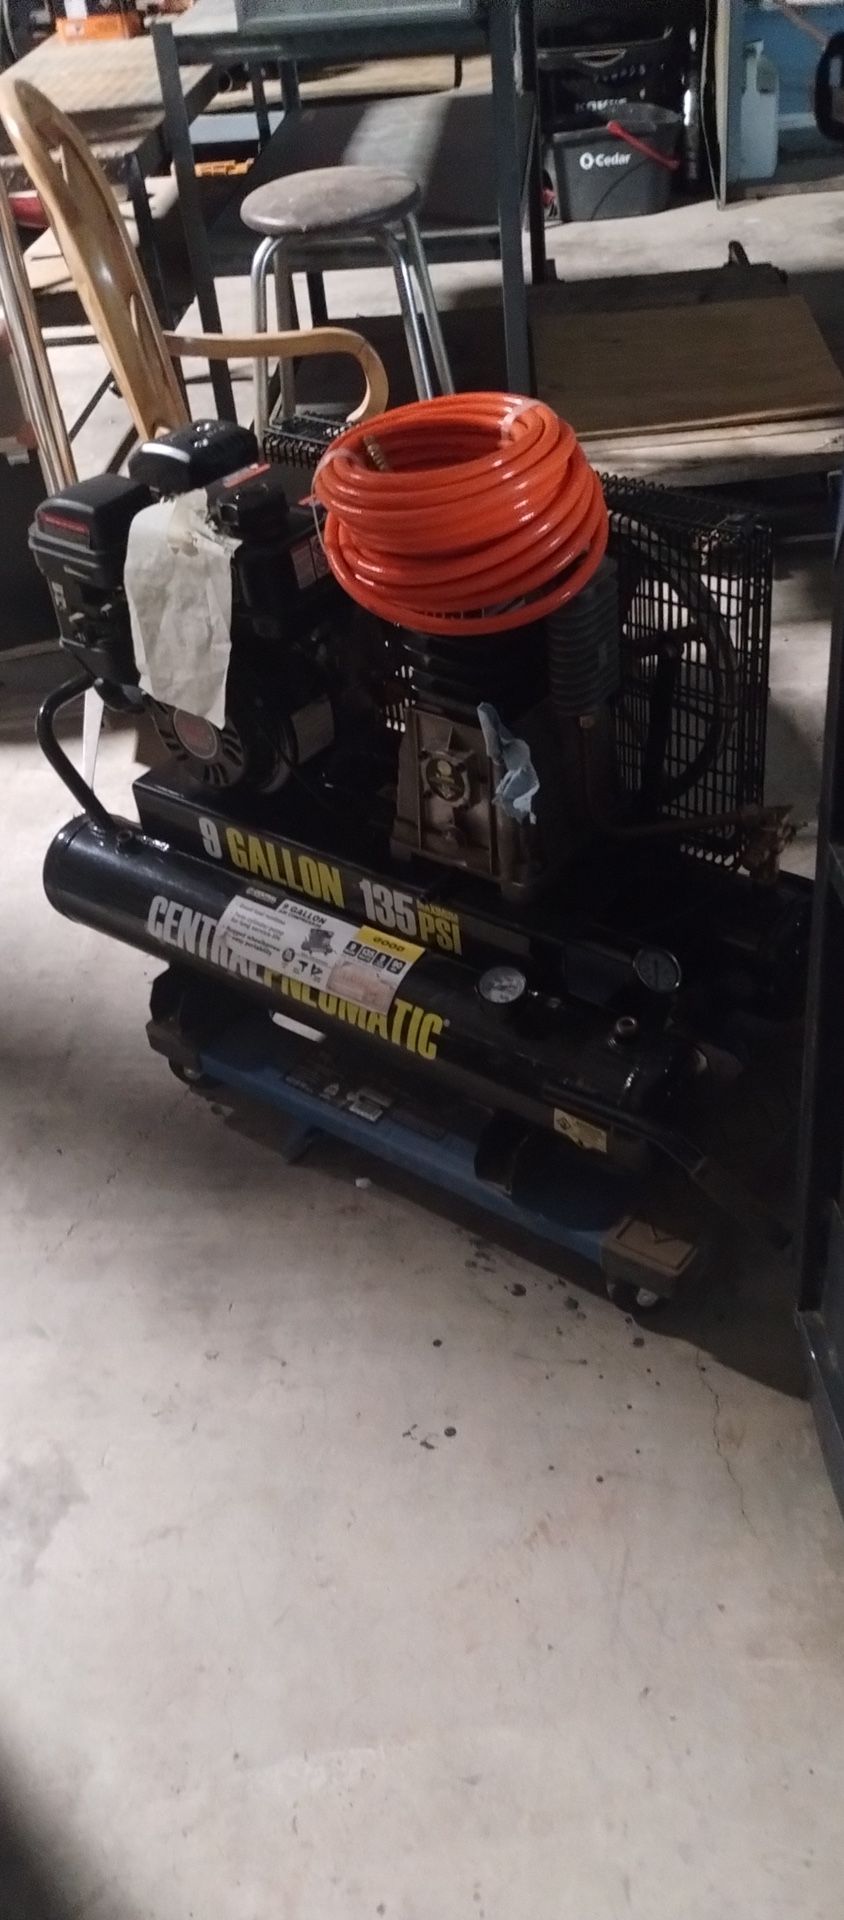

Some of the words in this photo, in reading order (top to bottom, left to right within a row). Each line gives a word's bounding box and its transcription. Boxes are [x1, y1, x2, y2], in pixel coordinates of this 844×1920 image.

[199, 817, 222, 859] 9
[226, 827, 345, 909] GALLON
[290, 905, 327, 924] GALLON
[359, 878, 417, 937] 135
[373, 936, 405, 952] GOOD
[417, 911, 462, 955] PSI
